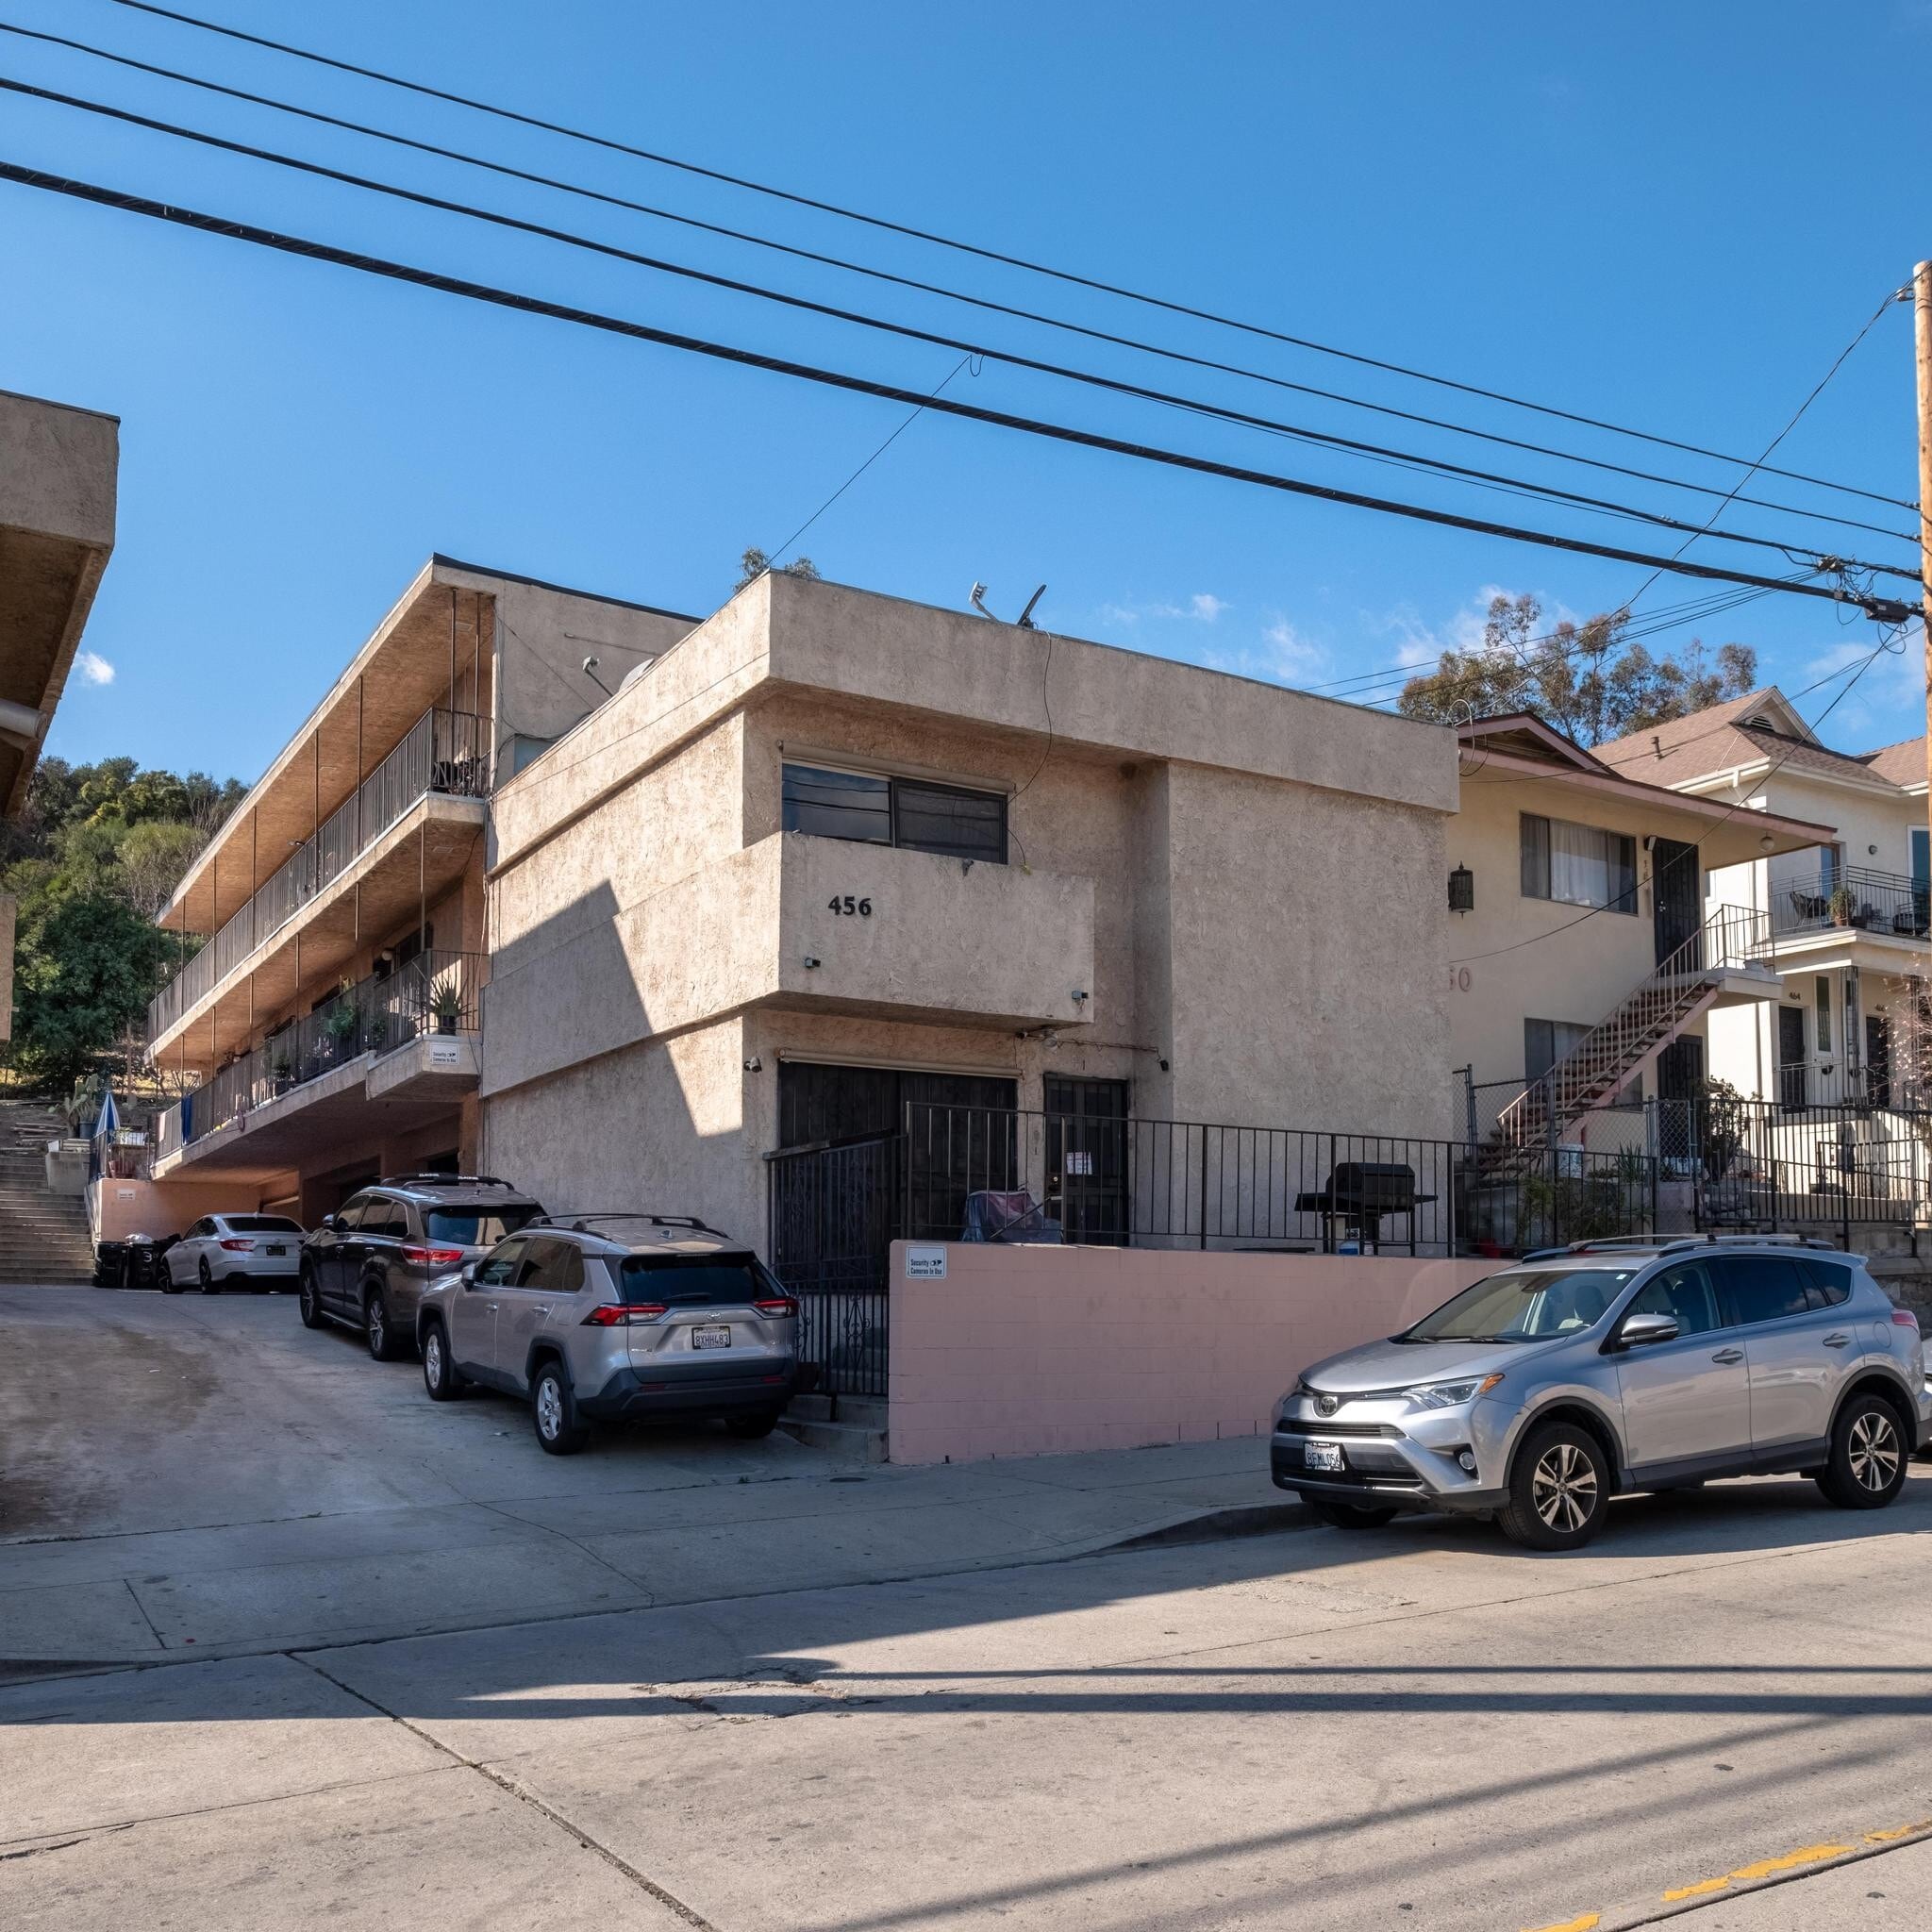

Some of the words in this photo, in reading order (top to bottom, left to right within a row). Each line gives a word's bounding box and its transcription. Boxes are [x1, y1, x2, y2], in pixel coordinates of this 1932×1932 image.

[828, 895, 872, 916] 456
[910, 1258, 929, 1267] Security
[695, 1334, 728, 1344] 8XHH483
